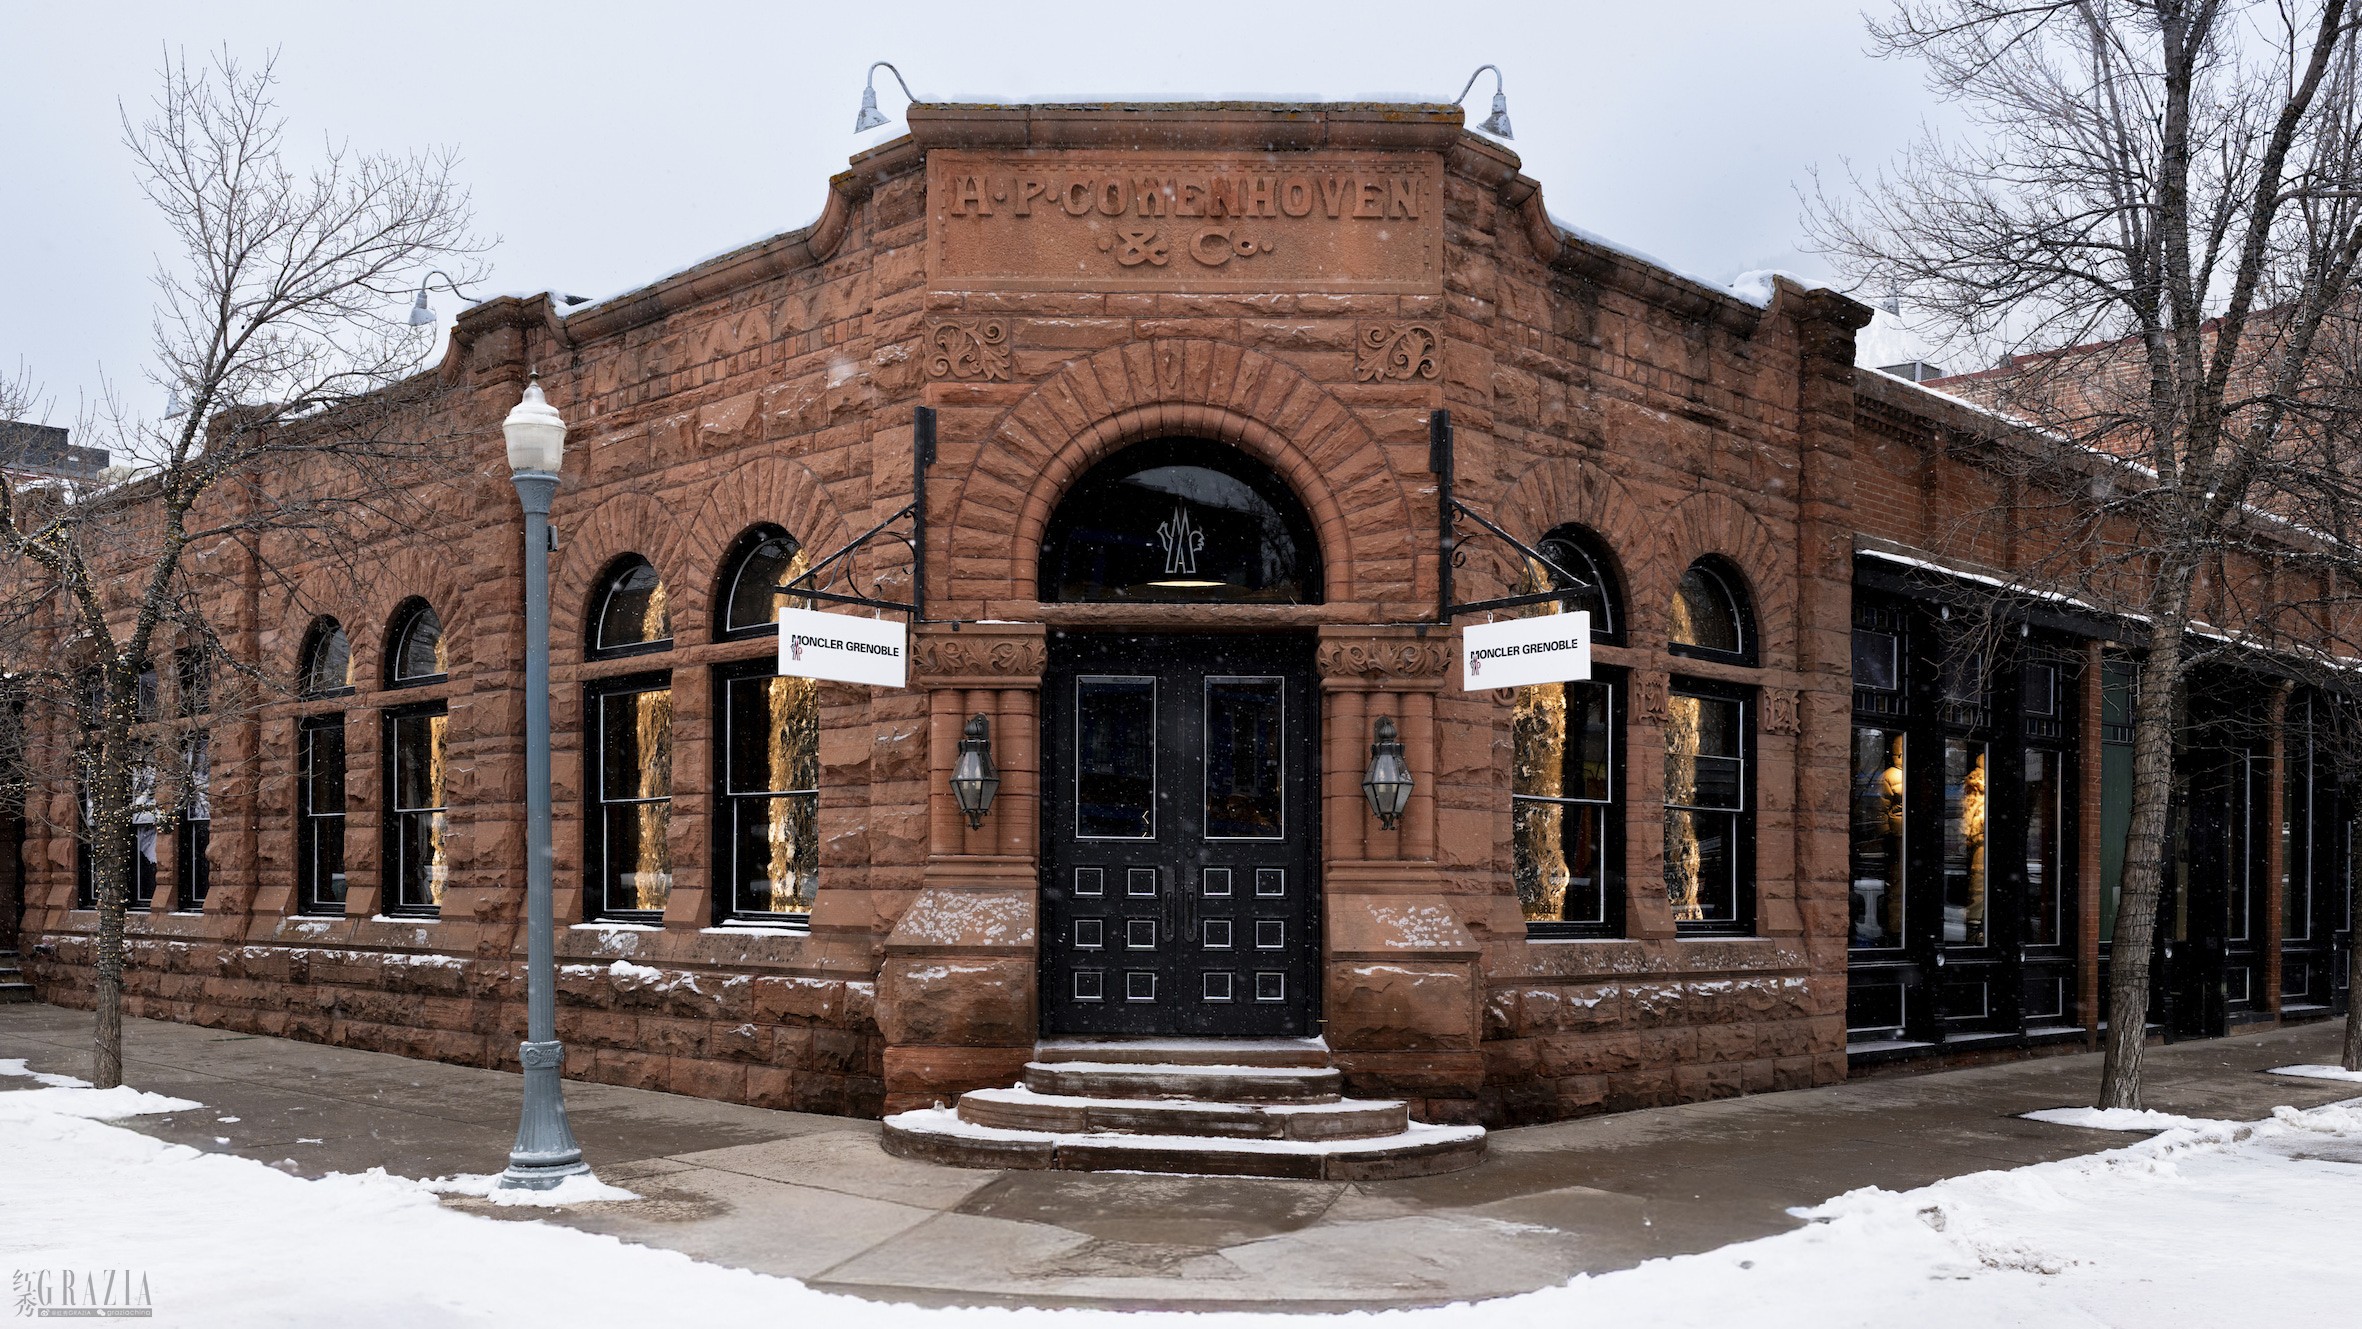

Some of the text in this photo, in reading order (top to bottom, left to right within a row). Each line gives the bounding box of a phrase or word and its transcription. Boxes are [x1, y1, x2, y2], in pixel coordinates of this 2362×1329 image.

[791, 634, 900, 657] MONCLER GRENOBLE
[1470, 638, 1578, 660] MONCLER GRENOBLE
